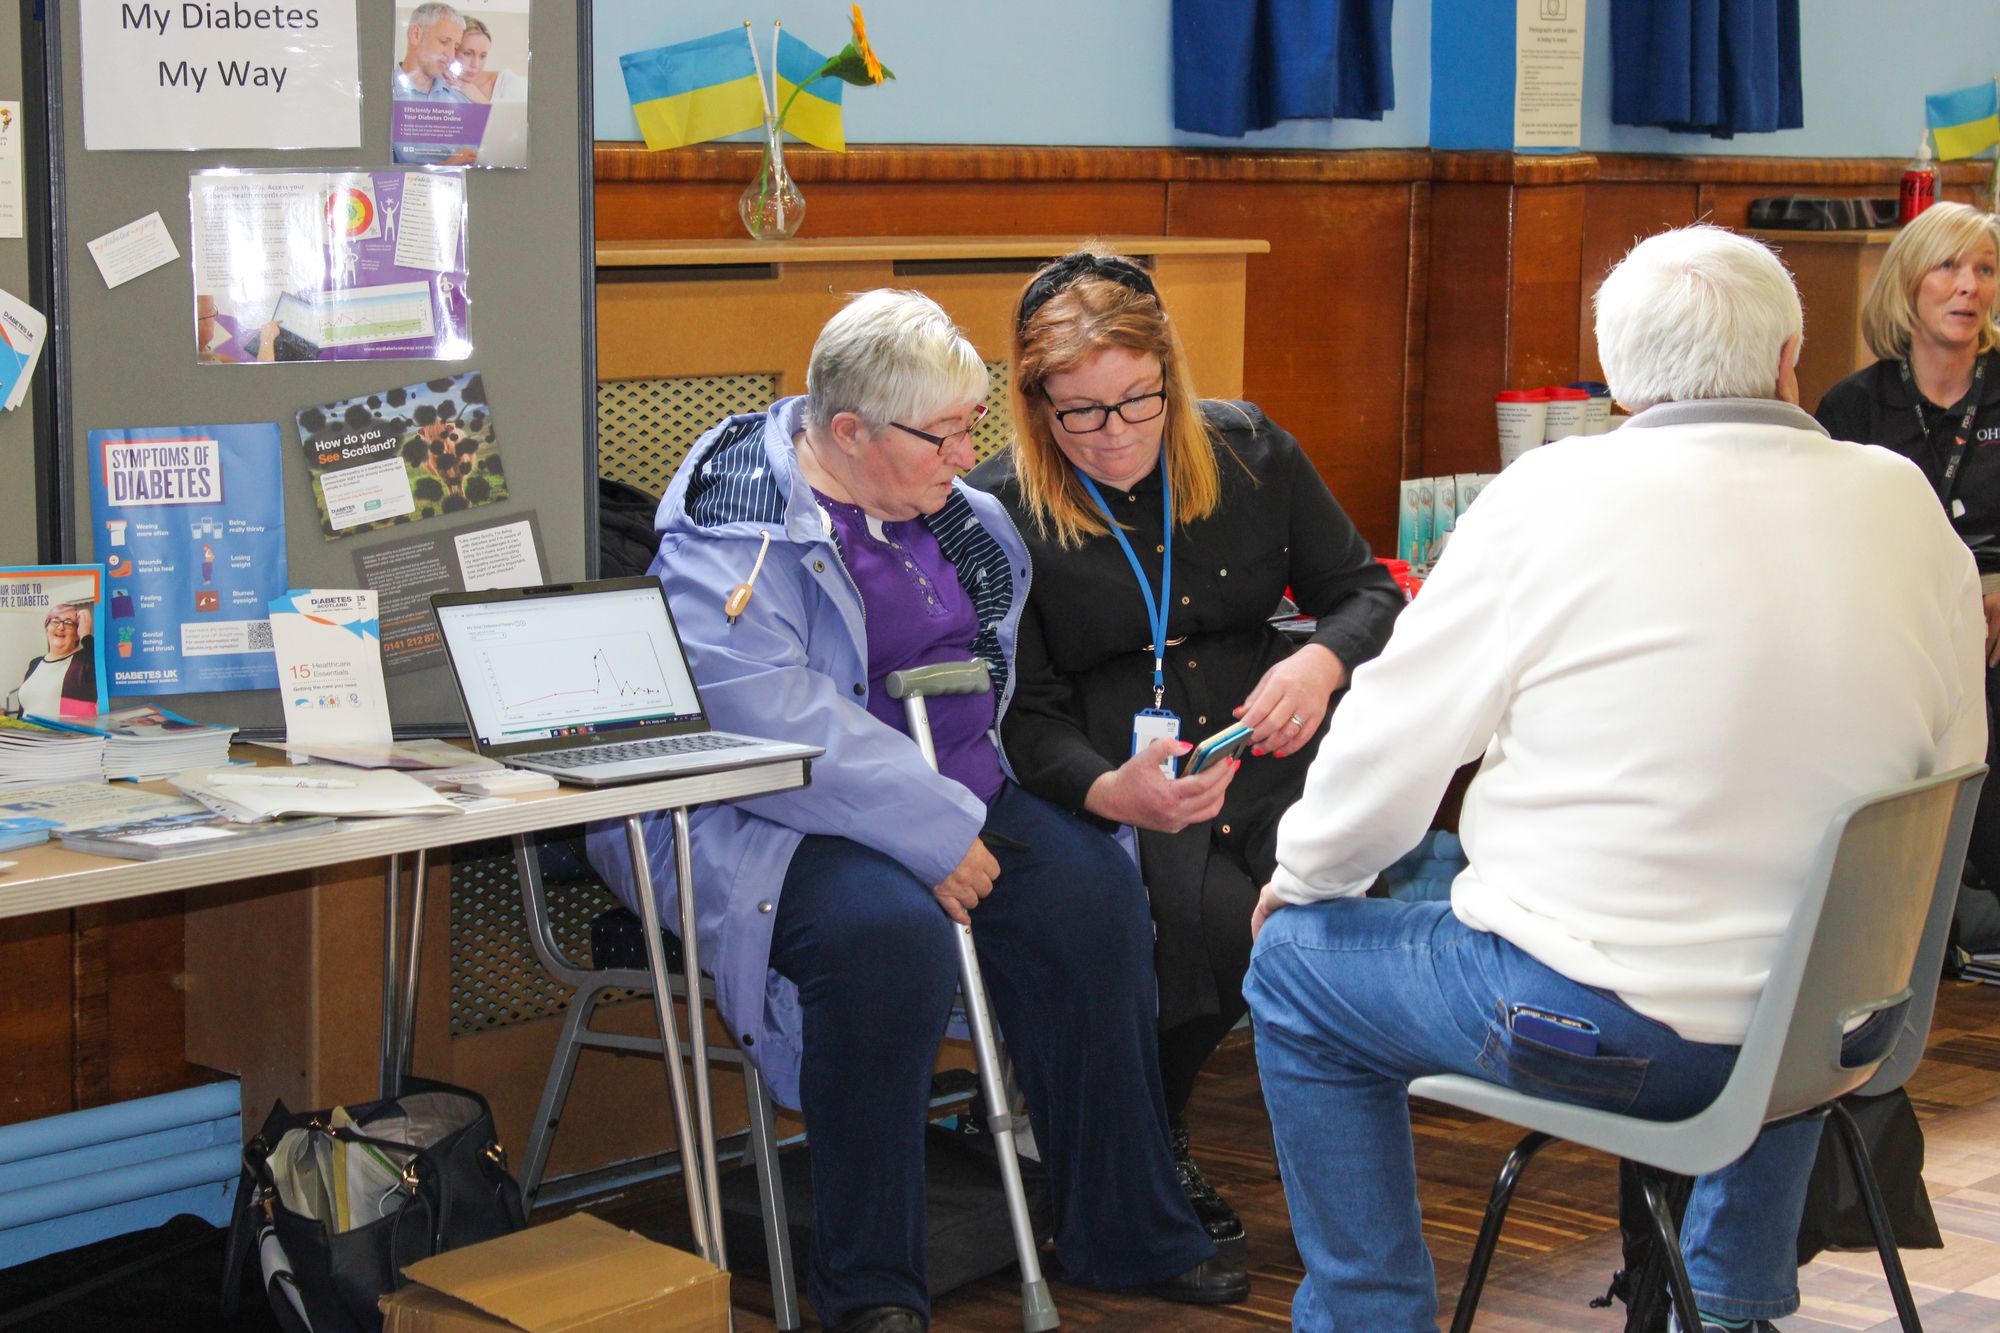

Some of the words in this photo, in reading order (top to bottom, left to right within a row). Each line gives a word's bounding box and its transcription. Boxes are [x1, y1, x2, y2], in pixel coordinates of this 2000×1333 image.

[122, 3, 170, 35] My
[183, 2, 319, 29] Diabetes
[159, 61, 207, 93] My
[218, 61, 288, 93] Way
[27, 330, 34, 339] UK
[316, 438, 340, 452] How
[344, 434, 358, 445] do
[360, 430, 381, 443] you
[318, 452, 340, 464] See
[342, 438, 396, 459] Scotland?
[112, 446, 189, 469] SYMPTOMS
[194, 446, 210, 466] OF
[114, 467, 212, 502] DIABETES
[136, 522, 158, 532] Weeing
[229, 520, 246, 528] Being
[246, 524, 264, 533] thirsty
[138, 558, 162, 566] Wounds
[230, 554, 251, 563] Losing
[11, 584, 30, 596] GUIDE
[33, 583, 42, 594] TO
[10, 596, 15, 608] 2
[17, 595, 49, 607] DIABETES
[140, 594, 162, 602] Feeling
[232, 596, 258, 605] eyesight
[142, 638, 164, 646] itching
[384, 640, 404, 652] 0141
[407, 636, 424, 648] 212
[424, 632, 440, 643] 871
[163, 670, 178, 678] UK
[290, 664, 311, 680] 15
[312, 661, 352, 669] Healthcare
[314, 669, 350, 678] Essentials
